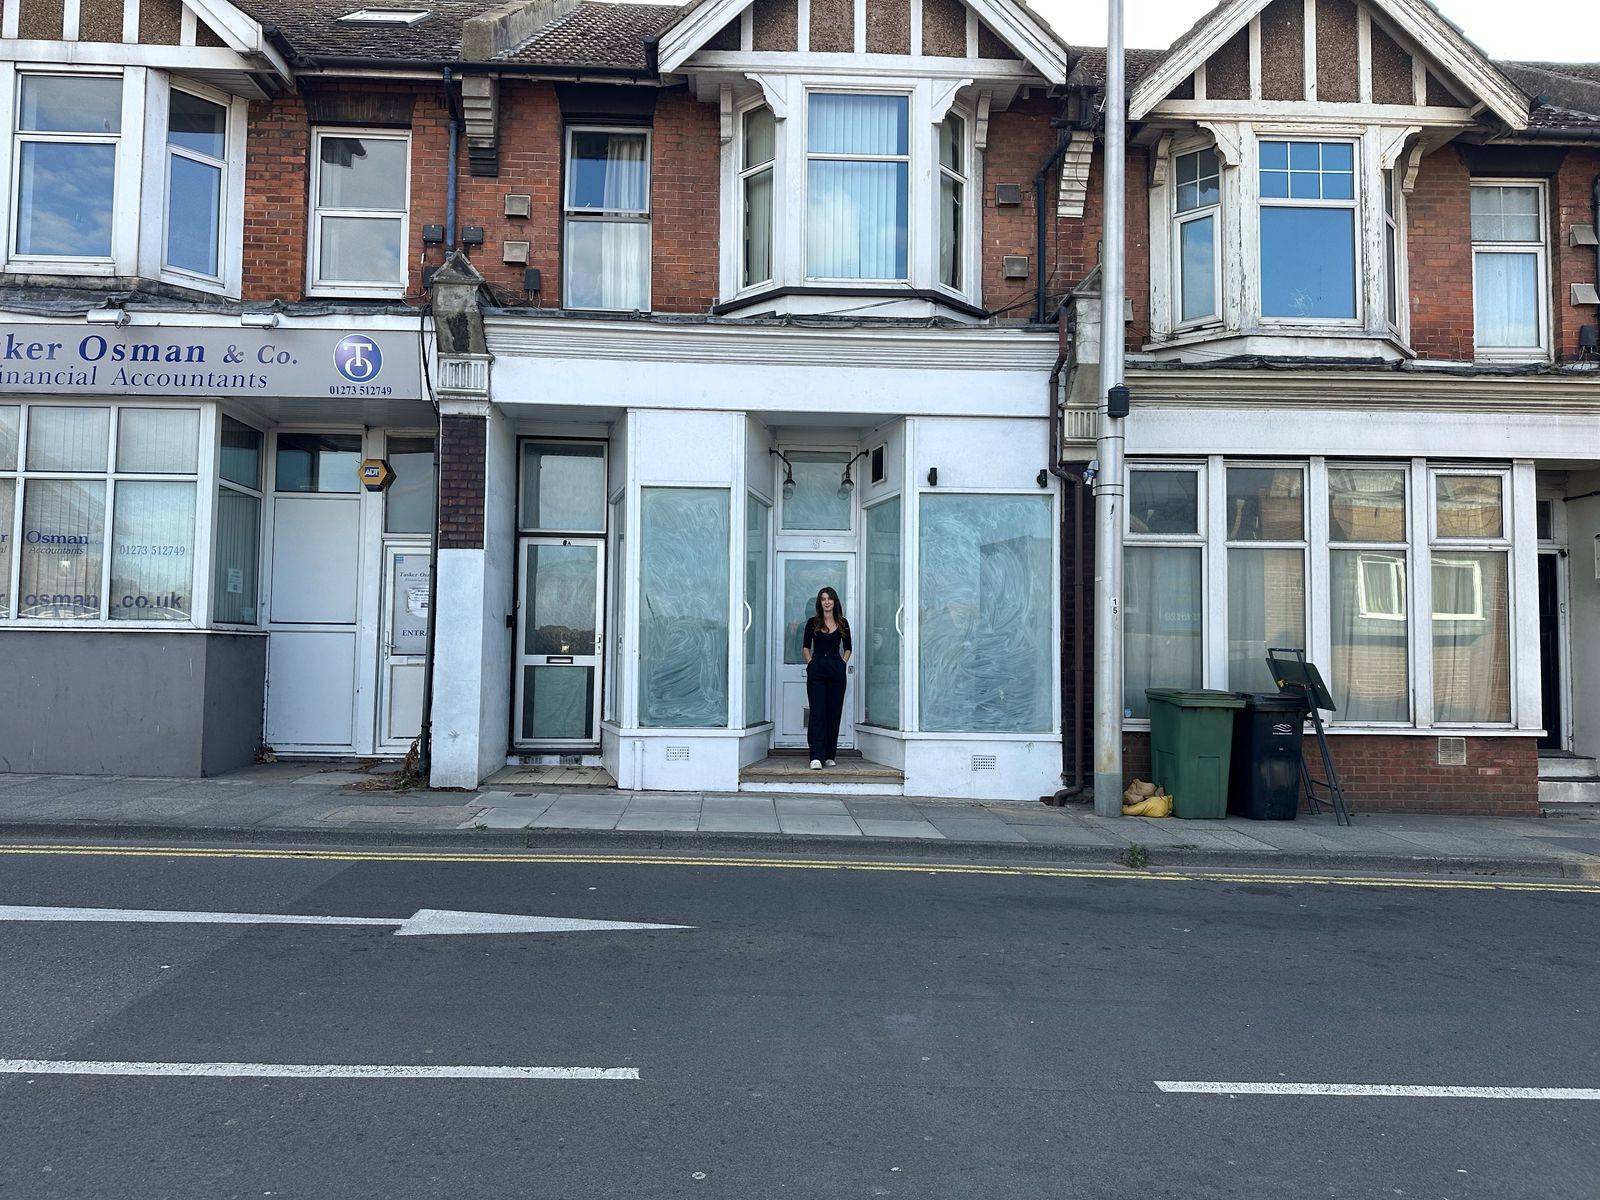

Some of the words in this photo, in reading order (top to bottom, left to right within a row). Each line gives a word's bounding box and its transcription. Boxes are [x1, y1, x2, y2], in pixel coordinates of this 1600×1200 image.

[0, 333, 62, 360] ker
[79, 335, 206, 363] Osman
[223, 344, 244, 364] &
[257, 344, 298, 365] Co.
[110, 367, 268, 389] Accountants
[329, 385, 357, 395] 01273
[359, 386, 392, 396] 512749
[364, 468, 380, 476] ADT
[26, 530, 89, 545] Osman
[29, 546, 85, 555] Accountants
[120, 545, 148, 555] 01273
[151, 545, 185, 556] 512749
[25, 594, 98, 608] osman
